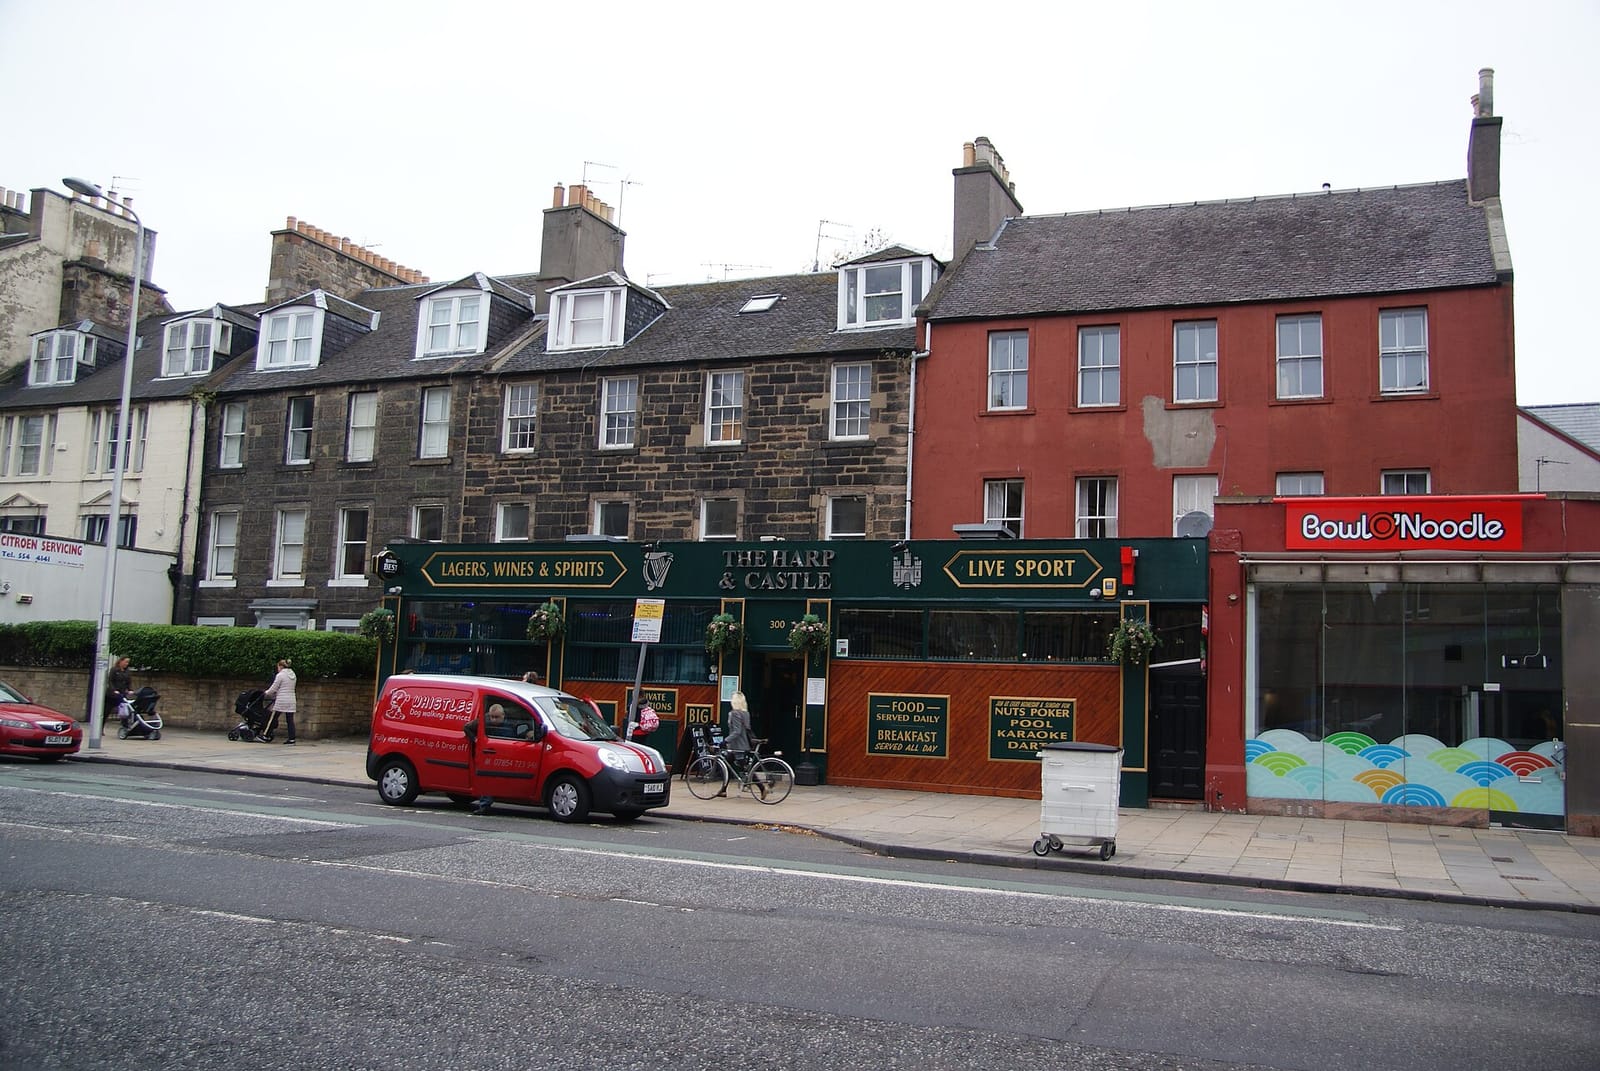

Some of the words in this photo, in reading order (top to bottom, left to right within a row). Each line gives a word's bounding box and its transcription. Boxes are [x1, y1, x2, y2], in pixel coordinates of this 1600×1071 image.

[1, 535, 38, 550] CITROEN
[41, 540, 83, 556] SERVICING
[2, 550, 15, 558] Tel.
[18, 552, 31, 560] 554
[722, 549, 767, 568] THE
[771, 549, 835, 568] HARP
[441, 561, 490, 578] LAGERS,
[493, 561, 534, 577] WINES
[539, 561, 549, 577] &
[554, 561, 605, 577] SPIRITS
[968, 559, 1005, 577] LIVE
[1015, 559, 1076, 577] SPORT
[718, 571, 736, 590] &
[744, 571, 832, 590] CASTLE
[769, 620, 785, 629] 300
[412, 695, 473, 714] WHISTLES
[892, 701, 925, 713] FOOD
[409, 708, 421, 717] Dog
[422, 710, 444, 720] walking
[689, 708, 709, 723] BIG
[876, 713, 910, 722] SERVED
[913, 715, 940, 723] DAILY
[994, 707, 1026, 716] NUTS
[1030, 708, 1070, 718] POKER
[1010, 719, 1053, 728] POOL
[877, 729, 937, 743] BREAKFAST
[997, 730, 1068, 740] KARAOKE
[874, 742, 903, 751] SERVED
[905, 743, 919, 752] ALL
[922, 744, 938, 753] DAY
